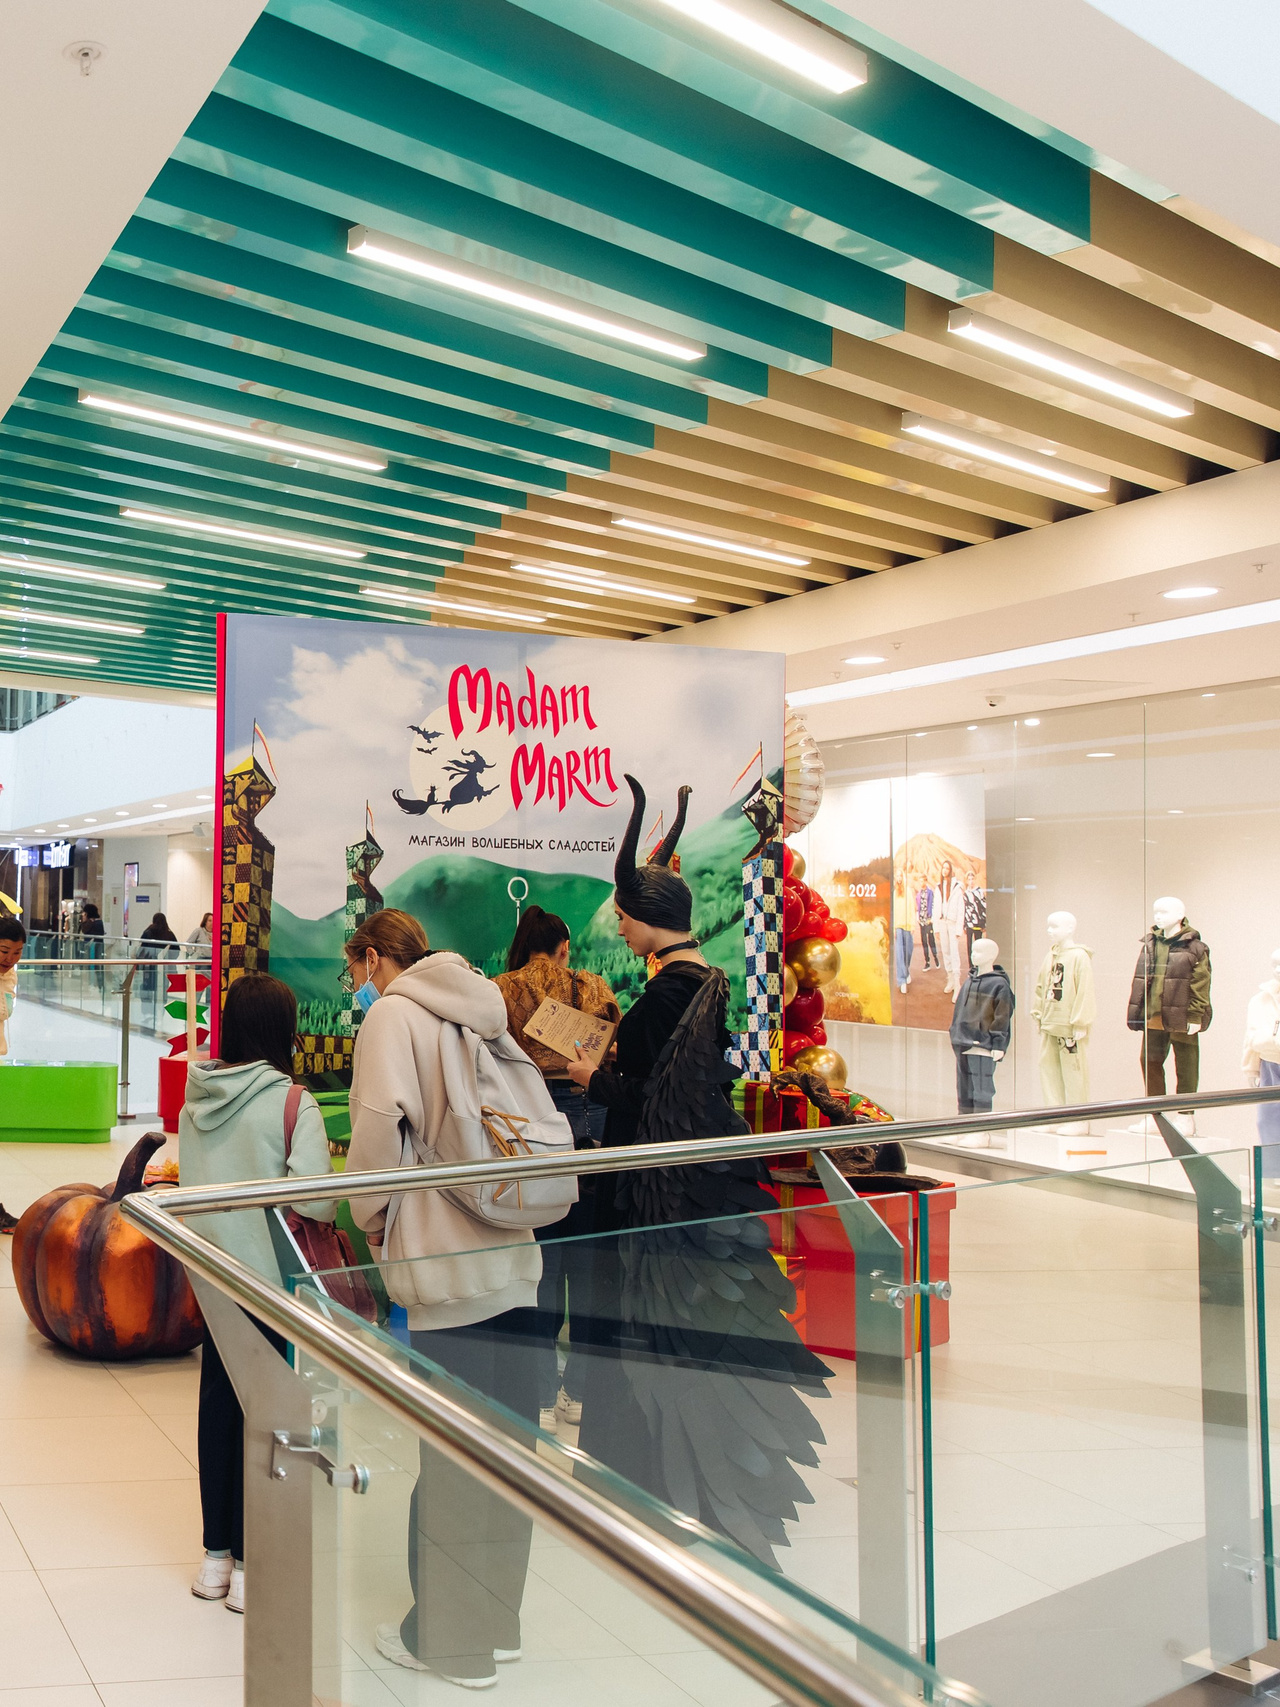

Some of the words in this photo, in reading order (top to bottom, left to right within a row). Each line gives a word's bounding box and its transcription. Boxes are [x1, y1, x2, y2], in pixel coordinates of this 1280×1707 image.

[408, 835, 466, 848] МАГАЗИН
[472, 837, 544, 850] ВОЛШЕБНЫХ
[548, 837, 616, 853] СЛАДОСТЕЙ
[849, 883, 877, 898] 2022
